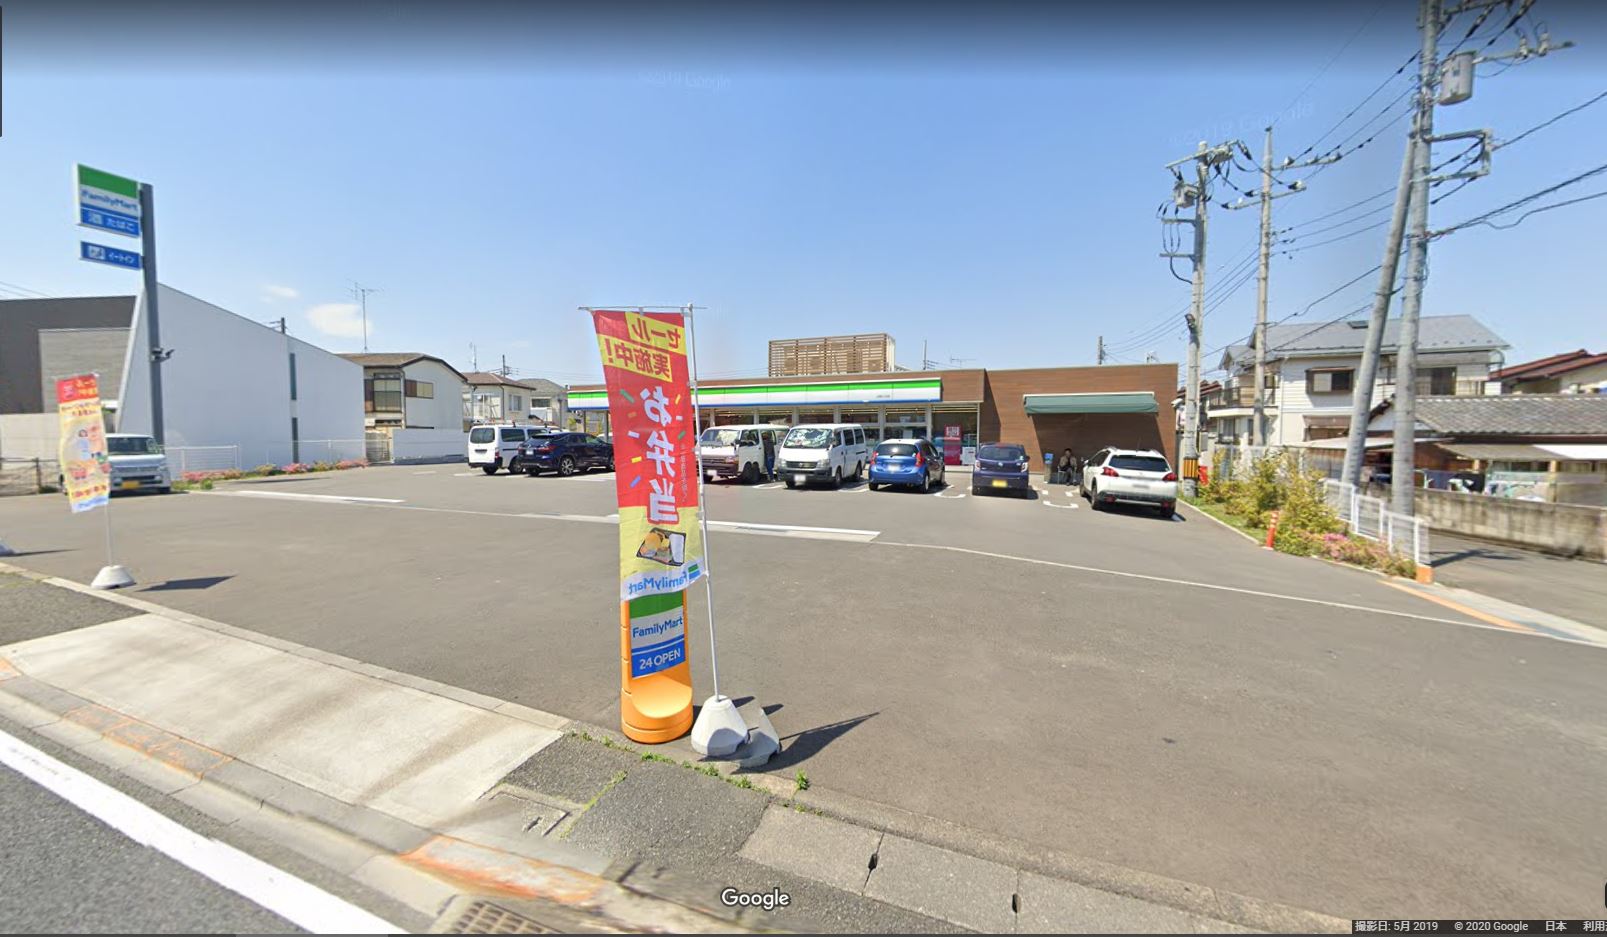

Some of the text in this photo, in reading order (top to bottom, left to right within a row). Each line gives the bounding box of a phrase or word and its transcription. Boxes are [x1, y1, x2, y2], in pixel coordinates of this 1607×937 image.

[81, 189, 138, 209] FamilyMart
[632, 616, 683, 638] FamilyMart
[654, 648, 681, 665] OPEN
